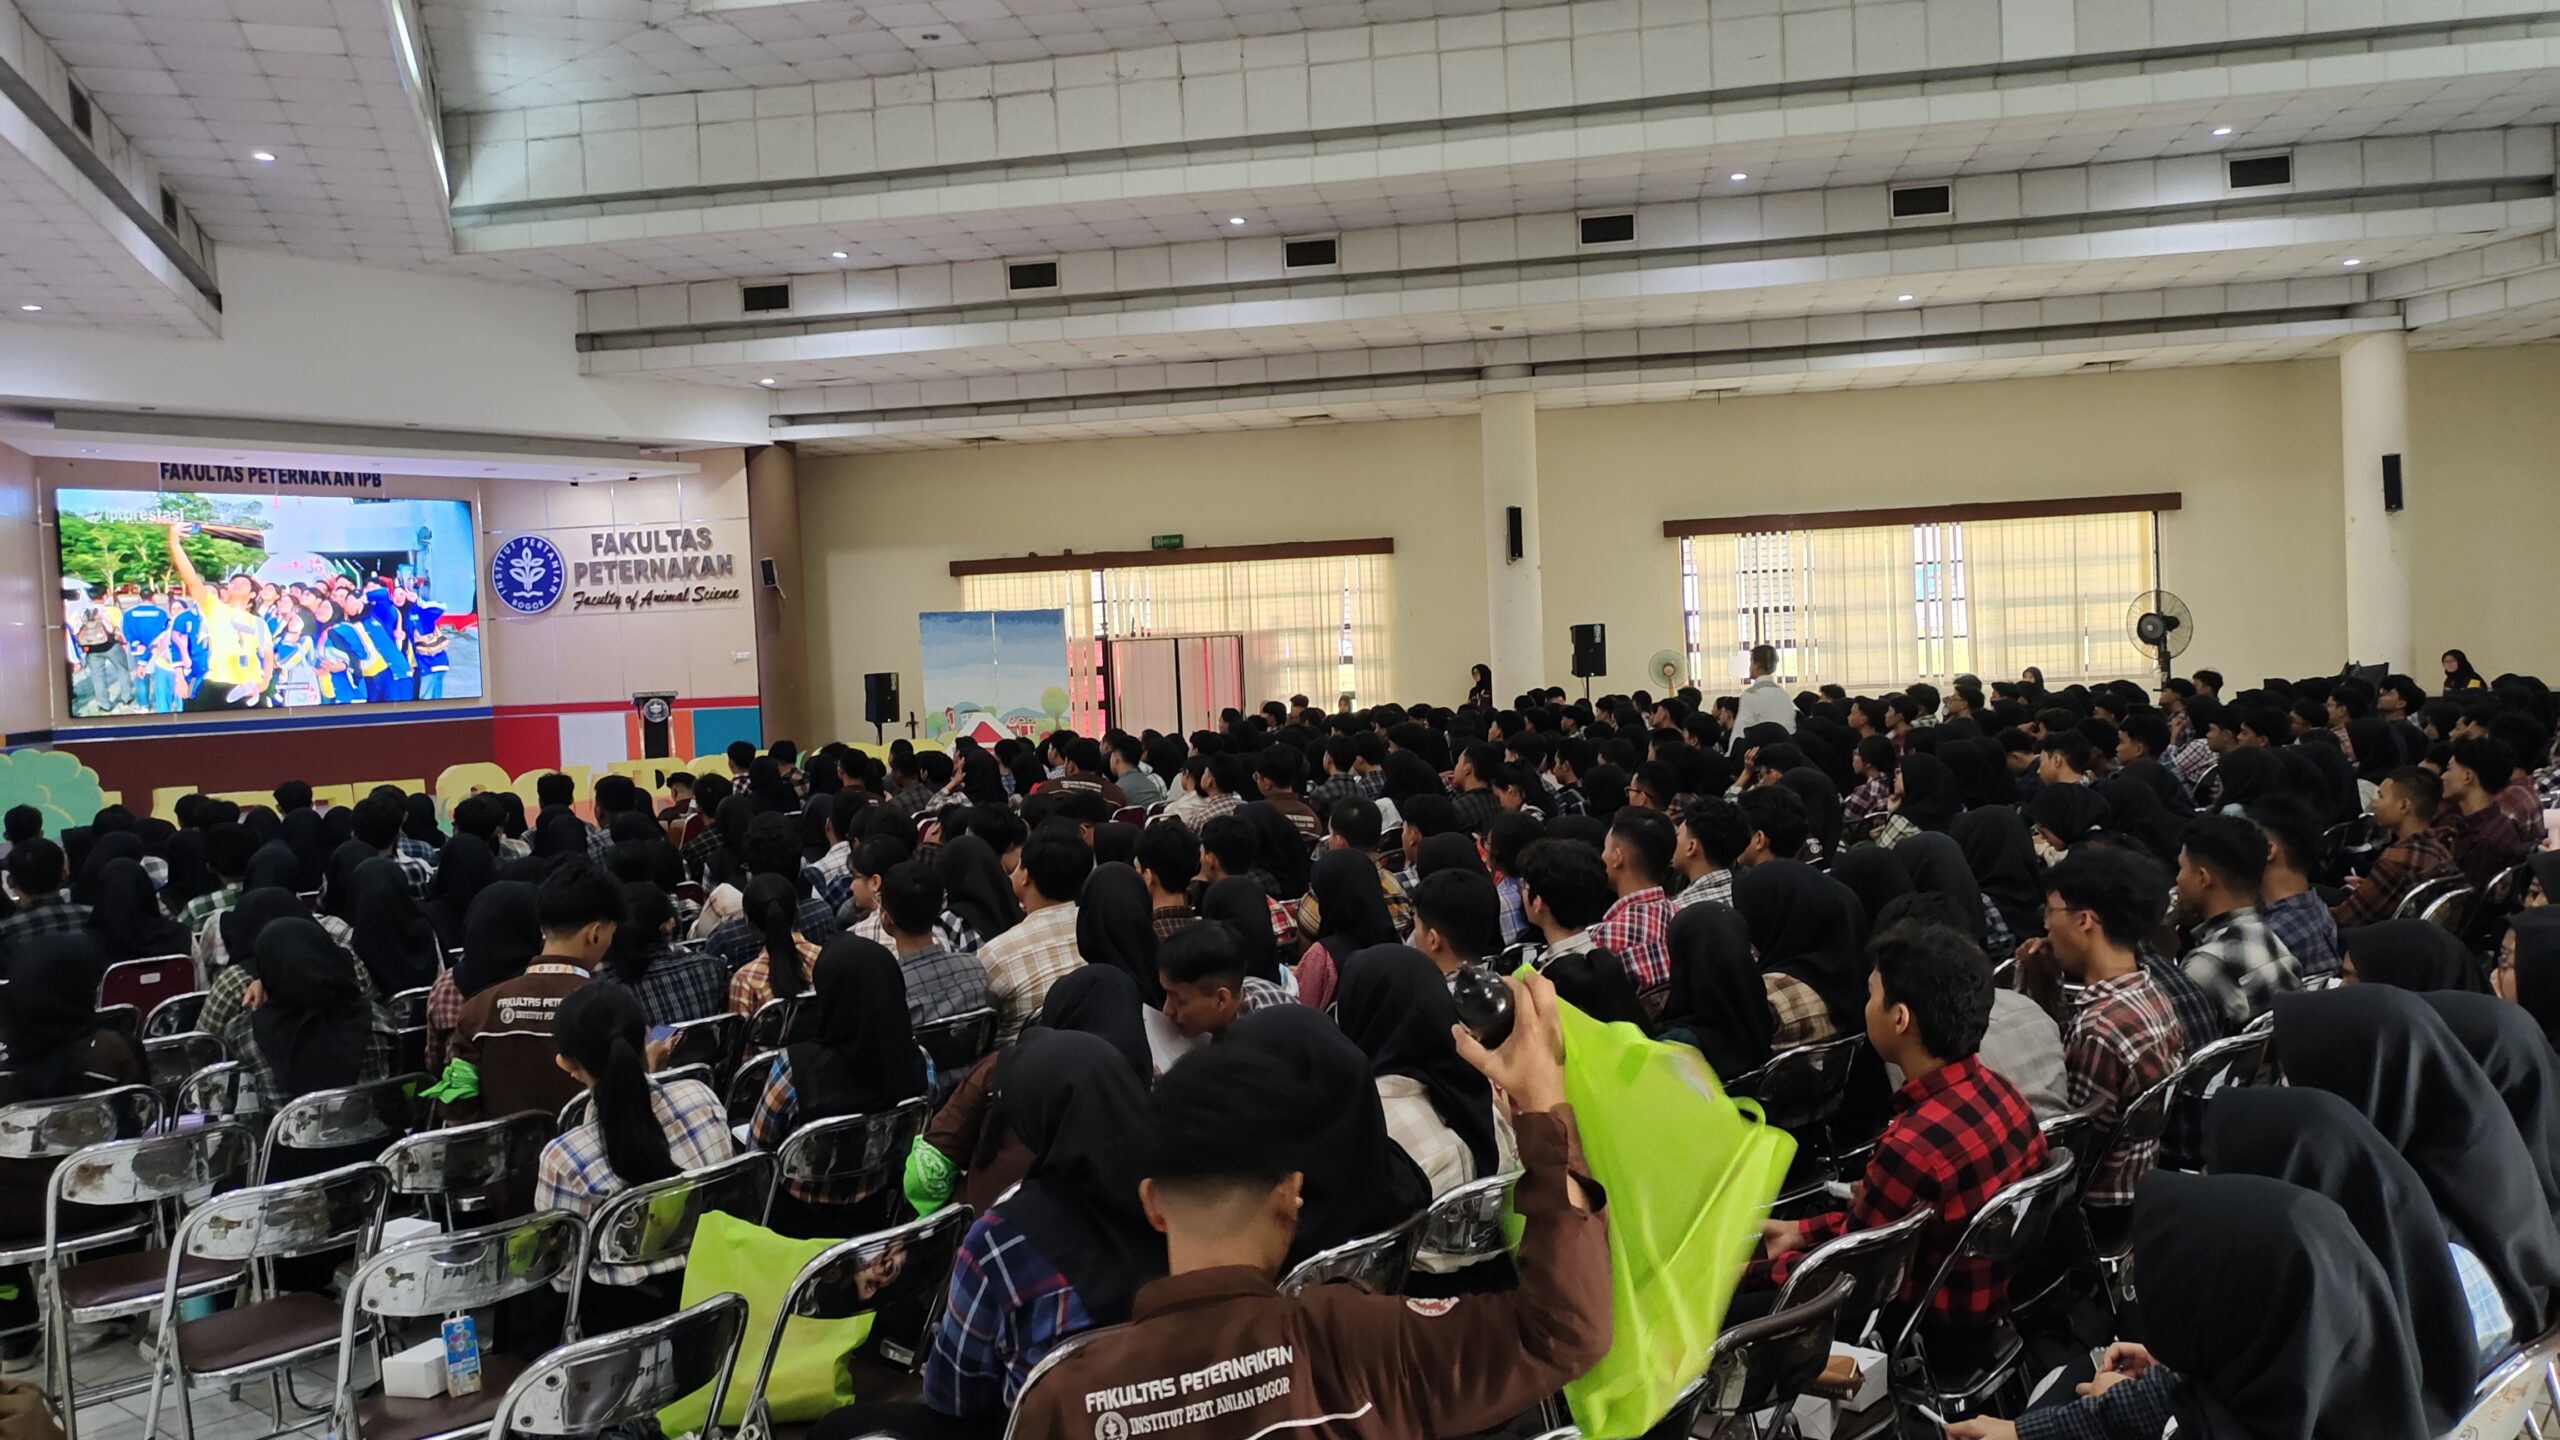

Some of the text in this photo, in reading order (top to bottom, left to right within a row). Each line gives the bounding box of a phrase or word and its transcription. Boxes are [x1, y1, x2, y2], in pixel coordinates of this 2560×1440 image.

[160, 462, 382, 488] FAKULTAS PETERNAKAN IPB
[591, 527, 713, 557] FAKULTAS
[495, 538, 560, 595] INSTITUT PERTANIAN
[573, 554, 734, 587] PETERNAKAN
[512, 599, 545, 610] BOGOR
[573, 586, 740, 611] Faculty of Animal Science
[497, 997, 541, 1009] FAKULTAS
[1085, 1345, 1294, 1413] FAKULTAS PETERNAKAN
[1128, 1406, 1184, 1436] INSTITUT
[1256, 1376, 1291, 1404] BOGOR
